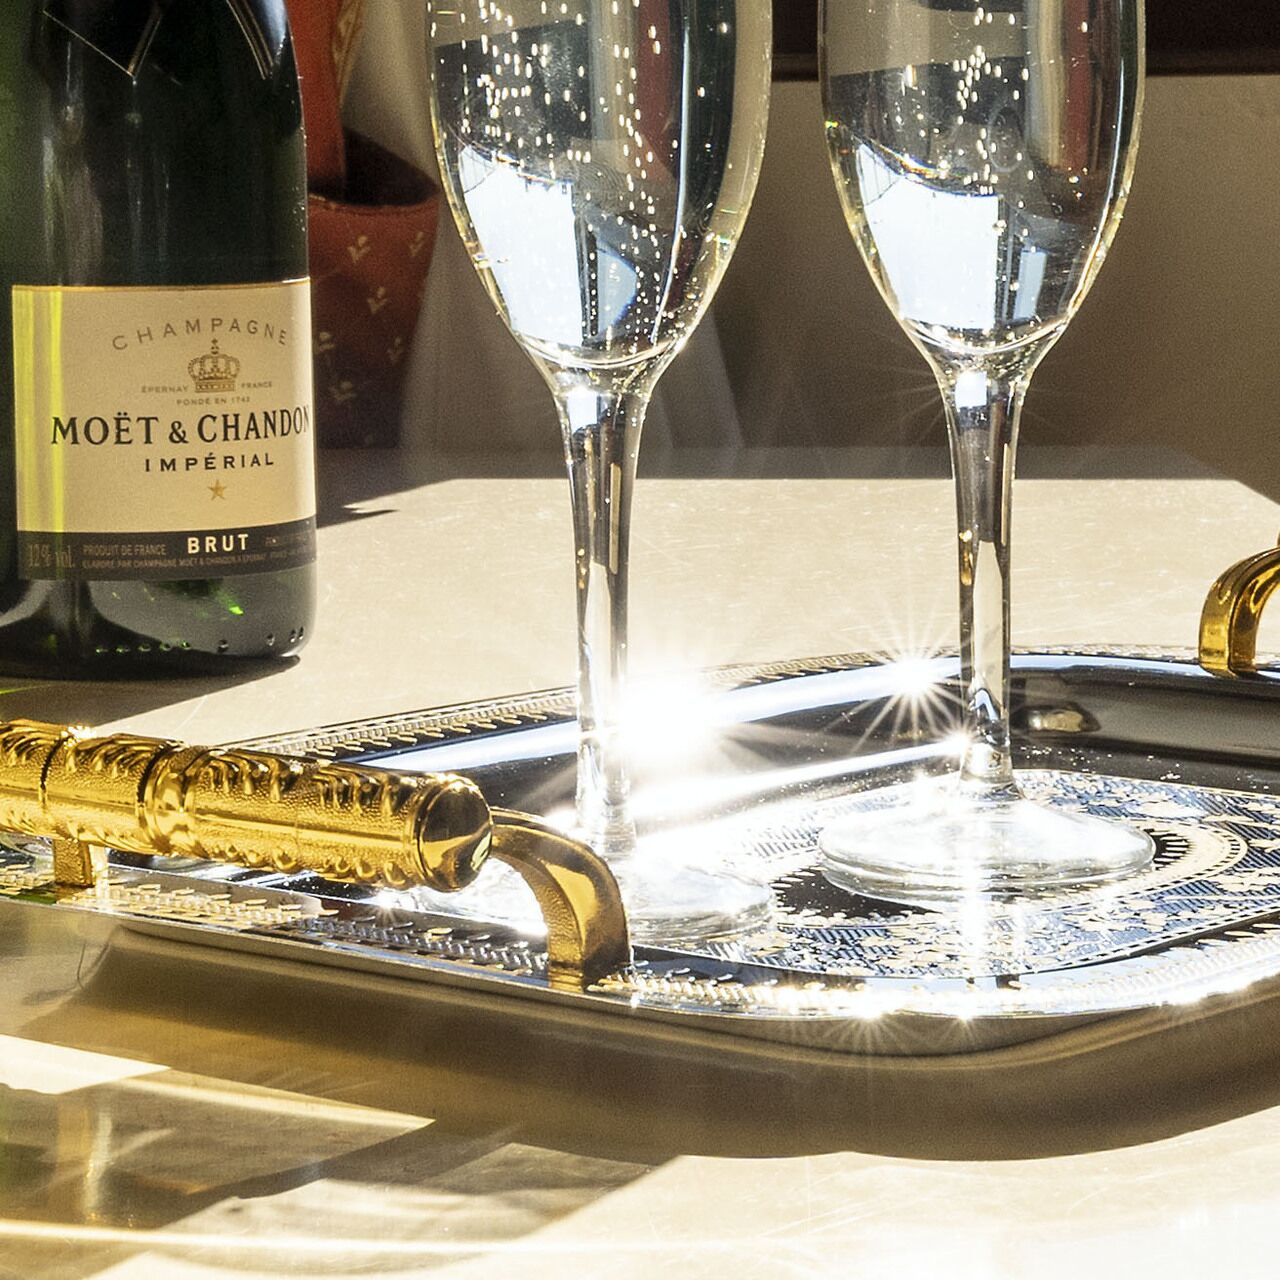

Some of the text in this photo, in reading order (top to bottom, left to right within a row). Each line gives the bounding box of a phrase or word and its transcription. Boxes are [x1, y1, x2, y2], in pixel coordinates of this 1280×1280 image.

[112, 317, 287, 350] CHAMPAGNE
[51, 405, 310, 445] MOËT & CHANDON
[145, 452, 274, 473] IMPÉRIAL
[187, 533, 248, 554] BRUT
